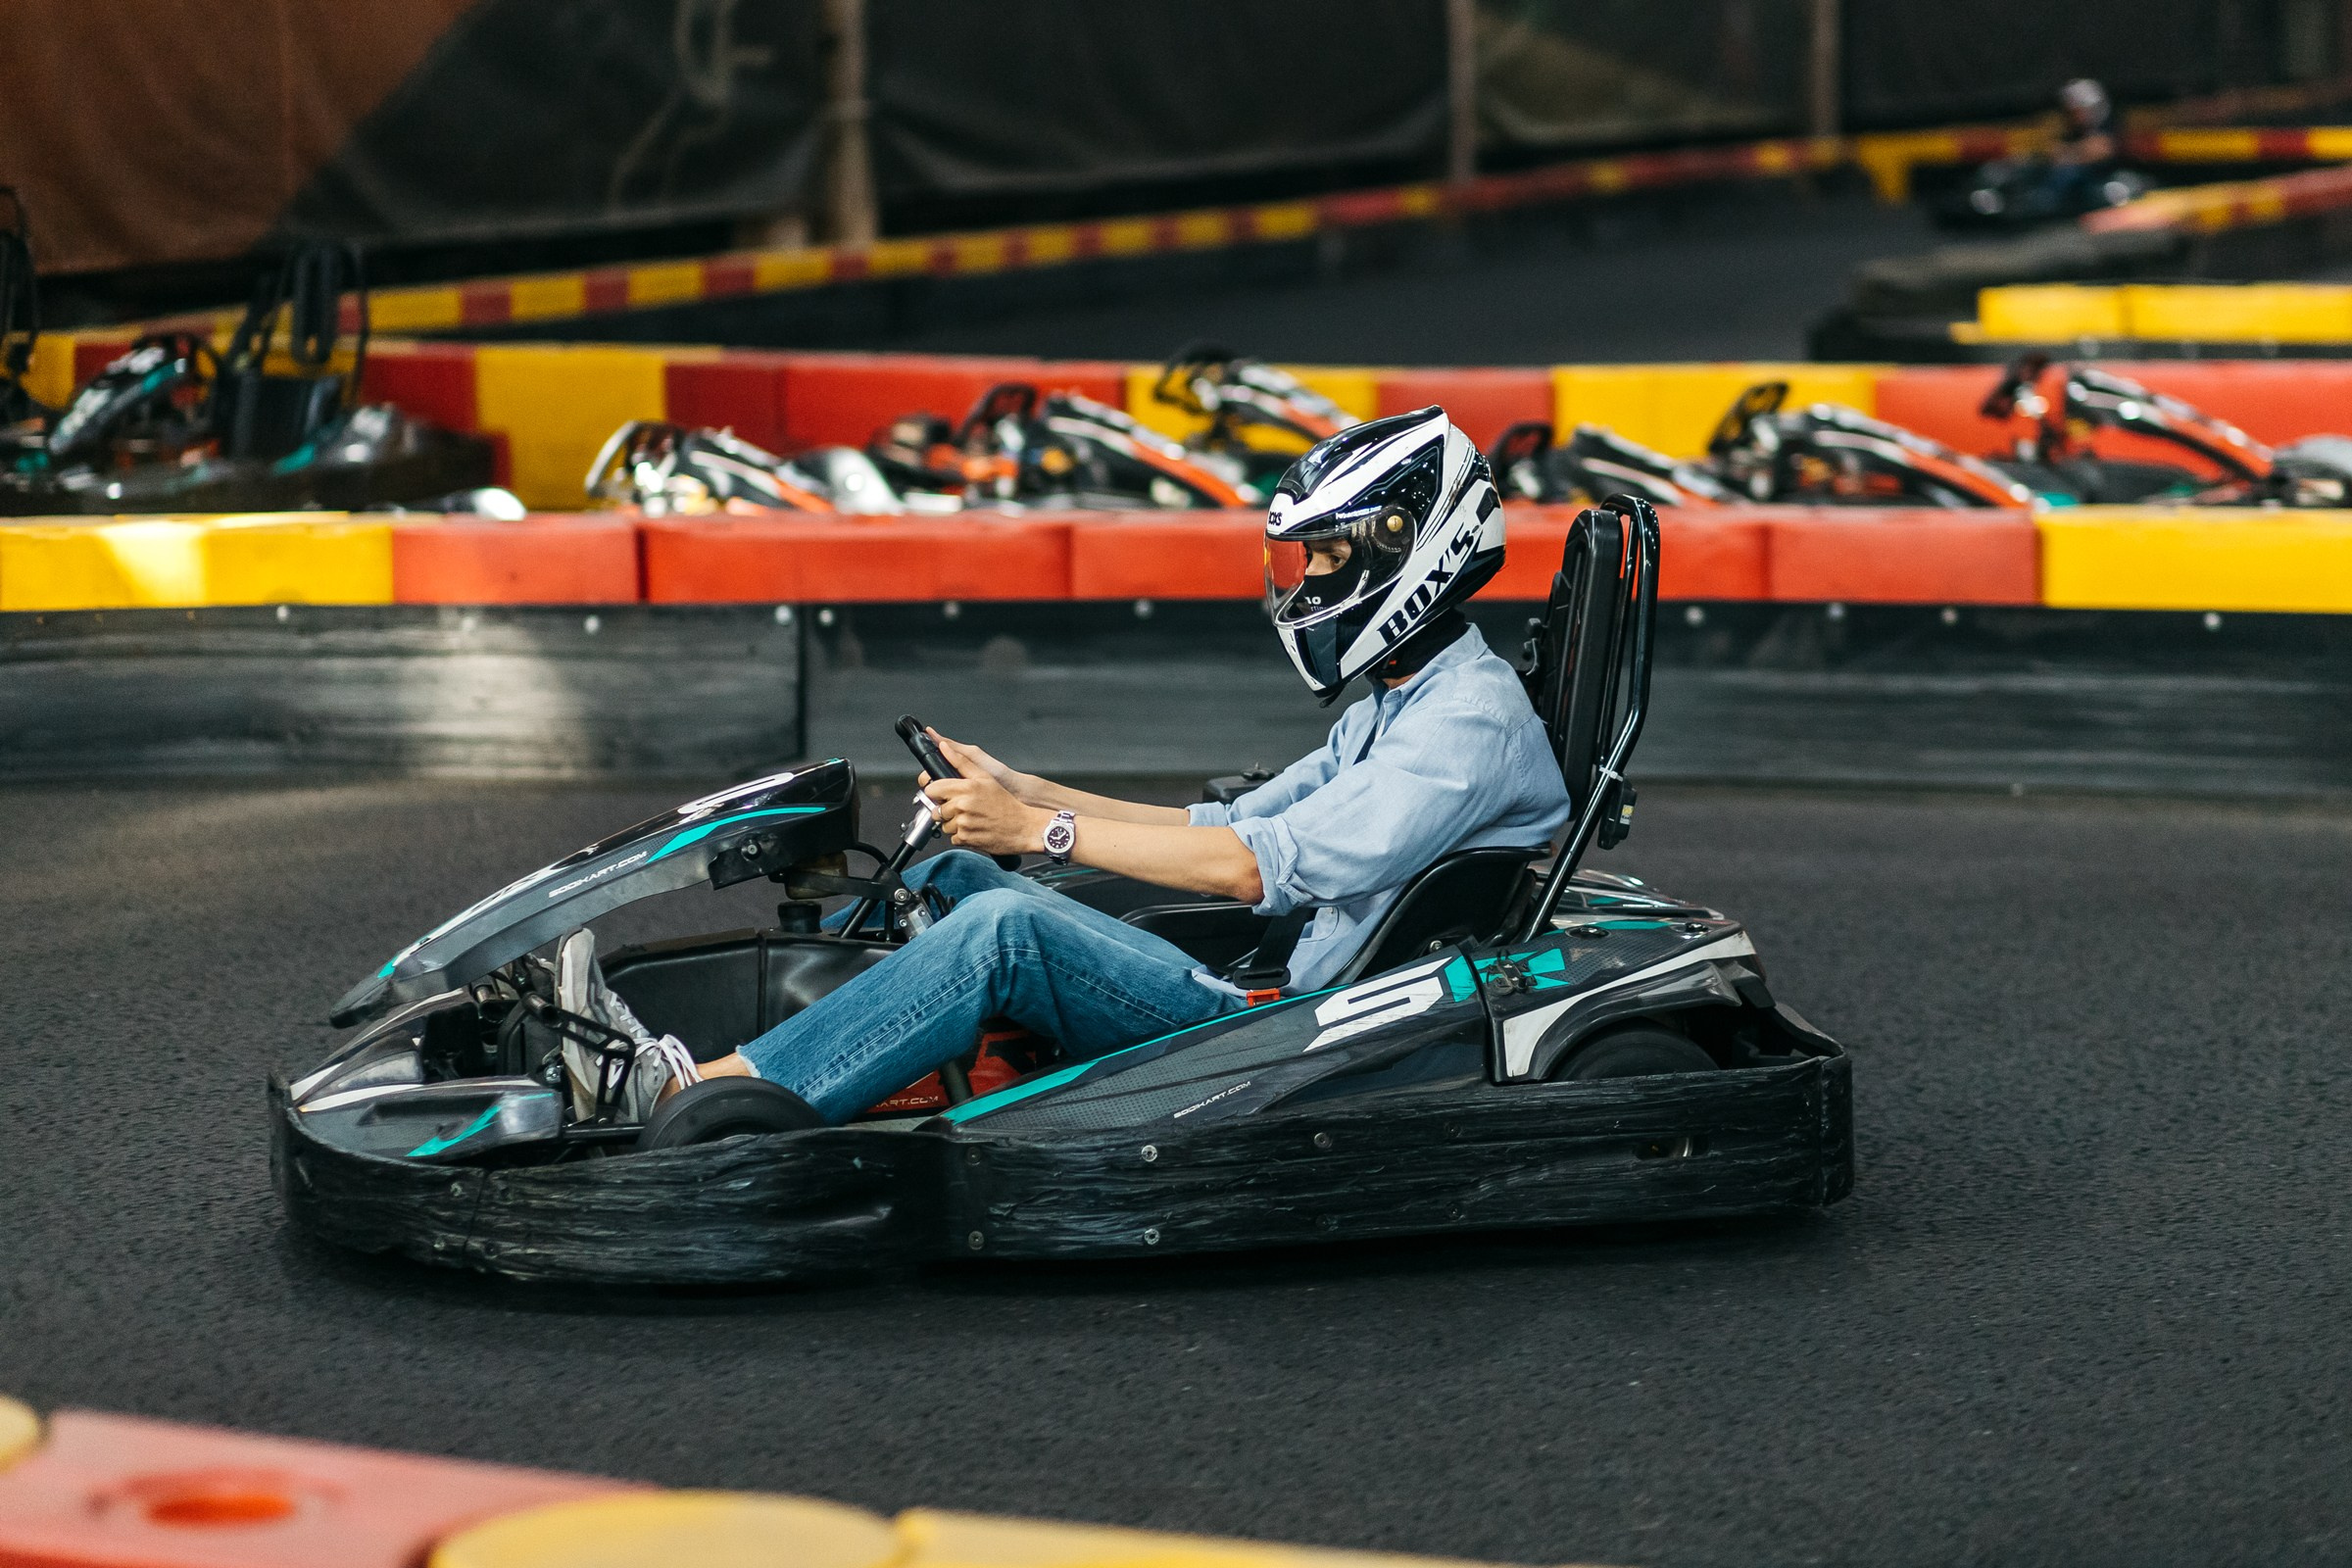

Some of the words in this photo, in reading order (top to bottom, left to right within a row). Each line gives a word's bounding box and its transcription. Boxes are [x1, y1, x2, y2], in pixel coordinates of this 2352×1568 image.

[1376, 521, 1474, 646] BOX'S
[549, 851, 647, 898] SODIKART.COM
[875, 1096, 939, 1107] ART.COM
[1173, 1081, 1251, 1118] SODIKART.COM
